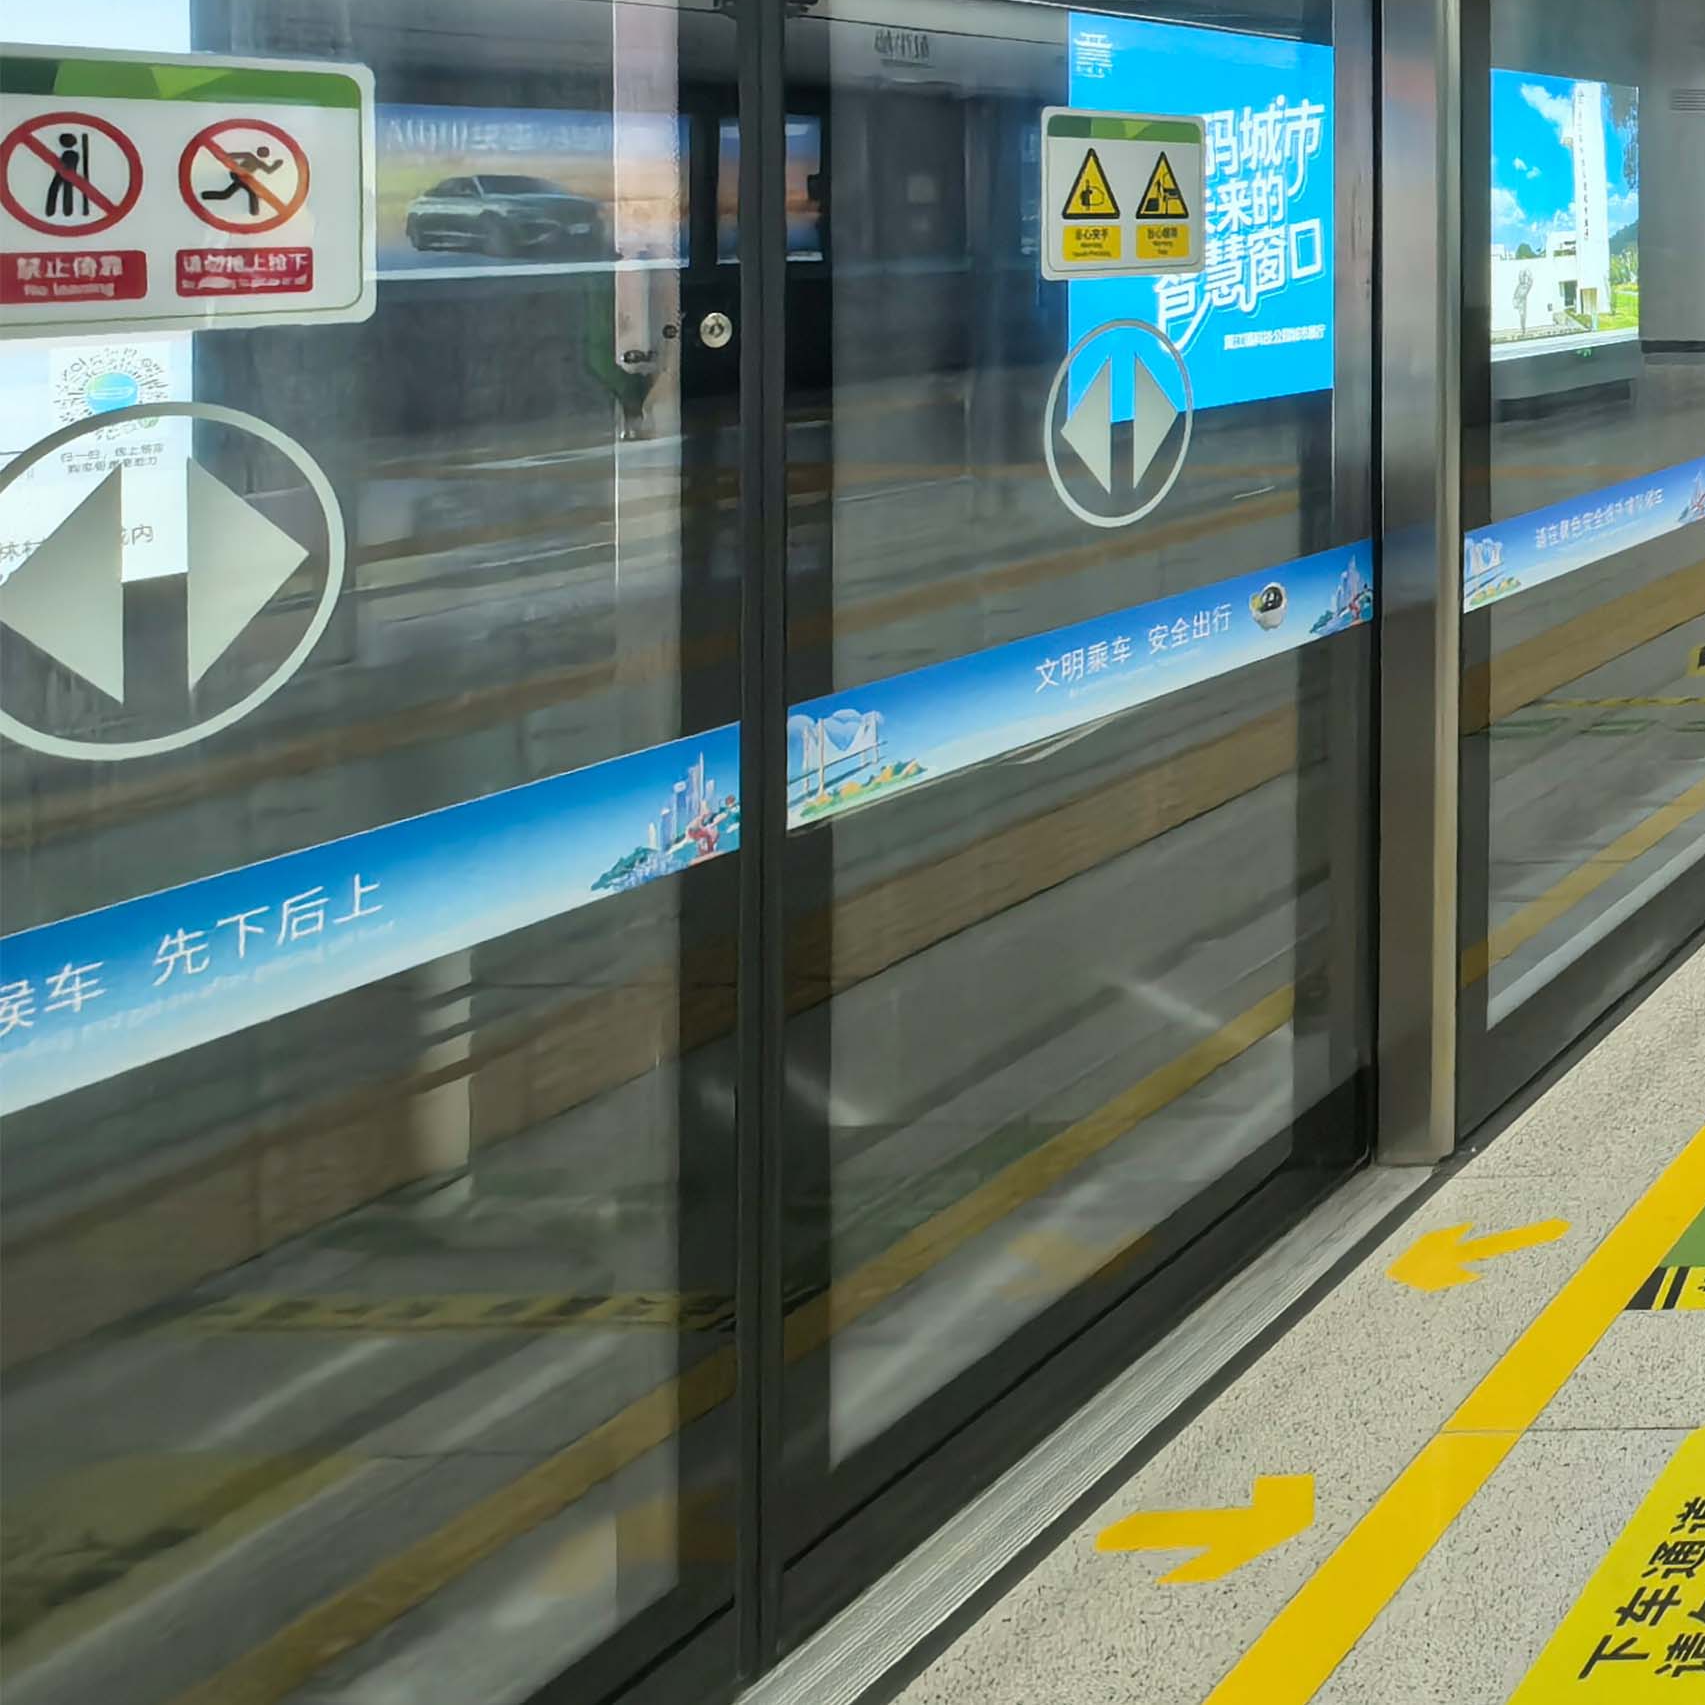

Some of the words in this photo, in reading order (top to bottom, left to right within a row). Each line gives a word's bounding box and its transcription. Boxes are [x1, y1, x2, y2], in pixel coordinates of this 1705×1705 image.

[1035, 636, 1132, 694] 文明乘车
[1148, 603, 1233, 656] 安全出行
[153, 873, 384, 987] 先下后上
